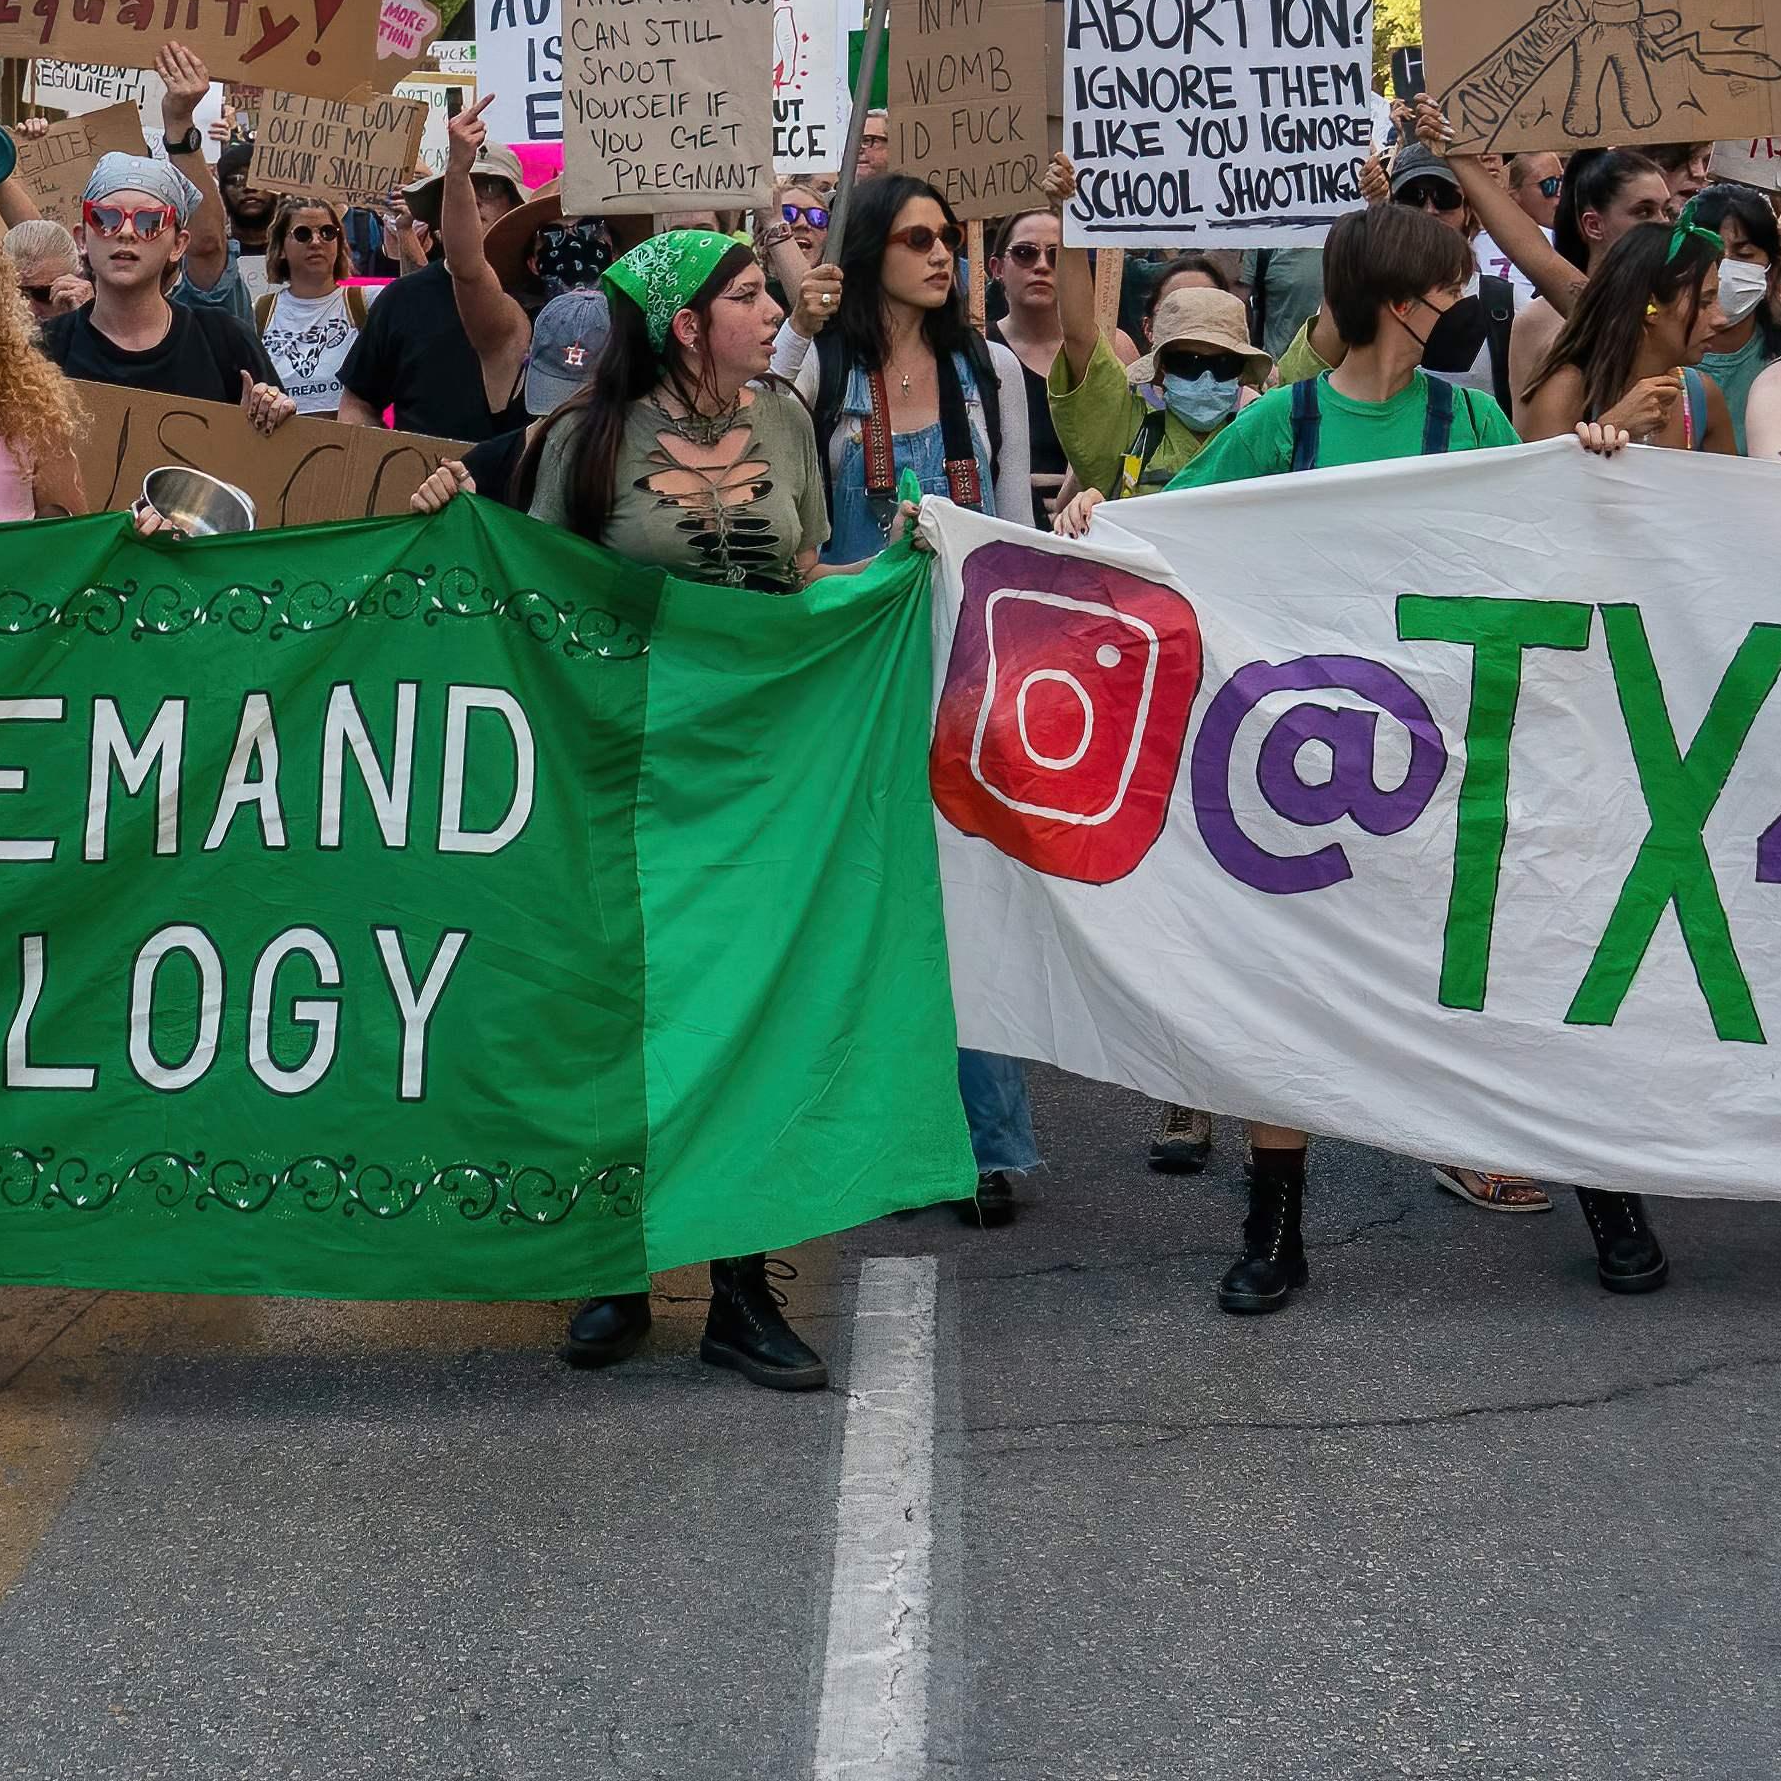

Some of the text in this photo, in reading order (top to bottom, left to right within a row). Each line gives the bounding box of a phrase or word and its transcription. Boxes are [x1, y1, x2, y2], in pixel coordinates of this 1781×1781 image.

[379, 20, 414, 49] THAN
[383, 2, 427, 32] MORE
[571, 19, 724, 52] CAN STILL
[907, 47, 1012, 104] WOMB
[1073, 64, 1237, 113] IGNORE
[1249, 61, 1367, 110] THEM
[362, 104, 419, 136] GOVT
[707, 91, 729, 118] IF
[269, 117, 378, 162] OUT OF MY
[590, 124, 742, 158] YOU GET
[899, 104, 1025, 164] ID FUCK
[1072, 114, 1374, 161] LIKE YOU IGNORE
[615, 158, 765, 194] PREGNANT
[1070, 158, 1366, 221] SCHOOL SHOOTINGS
